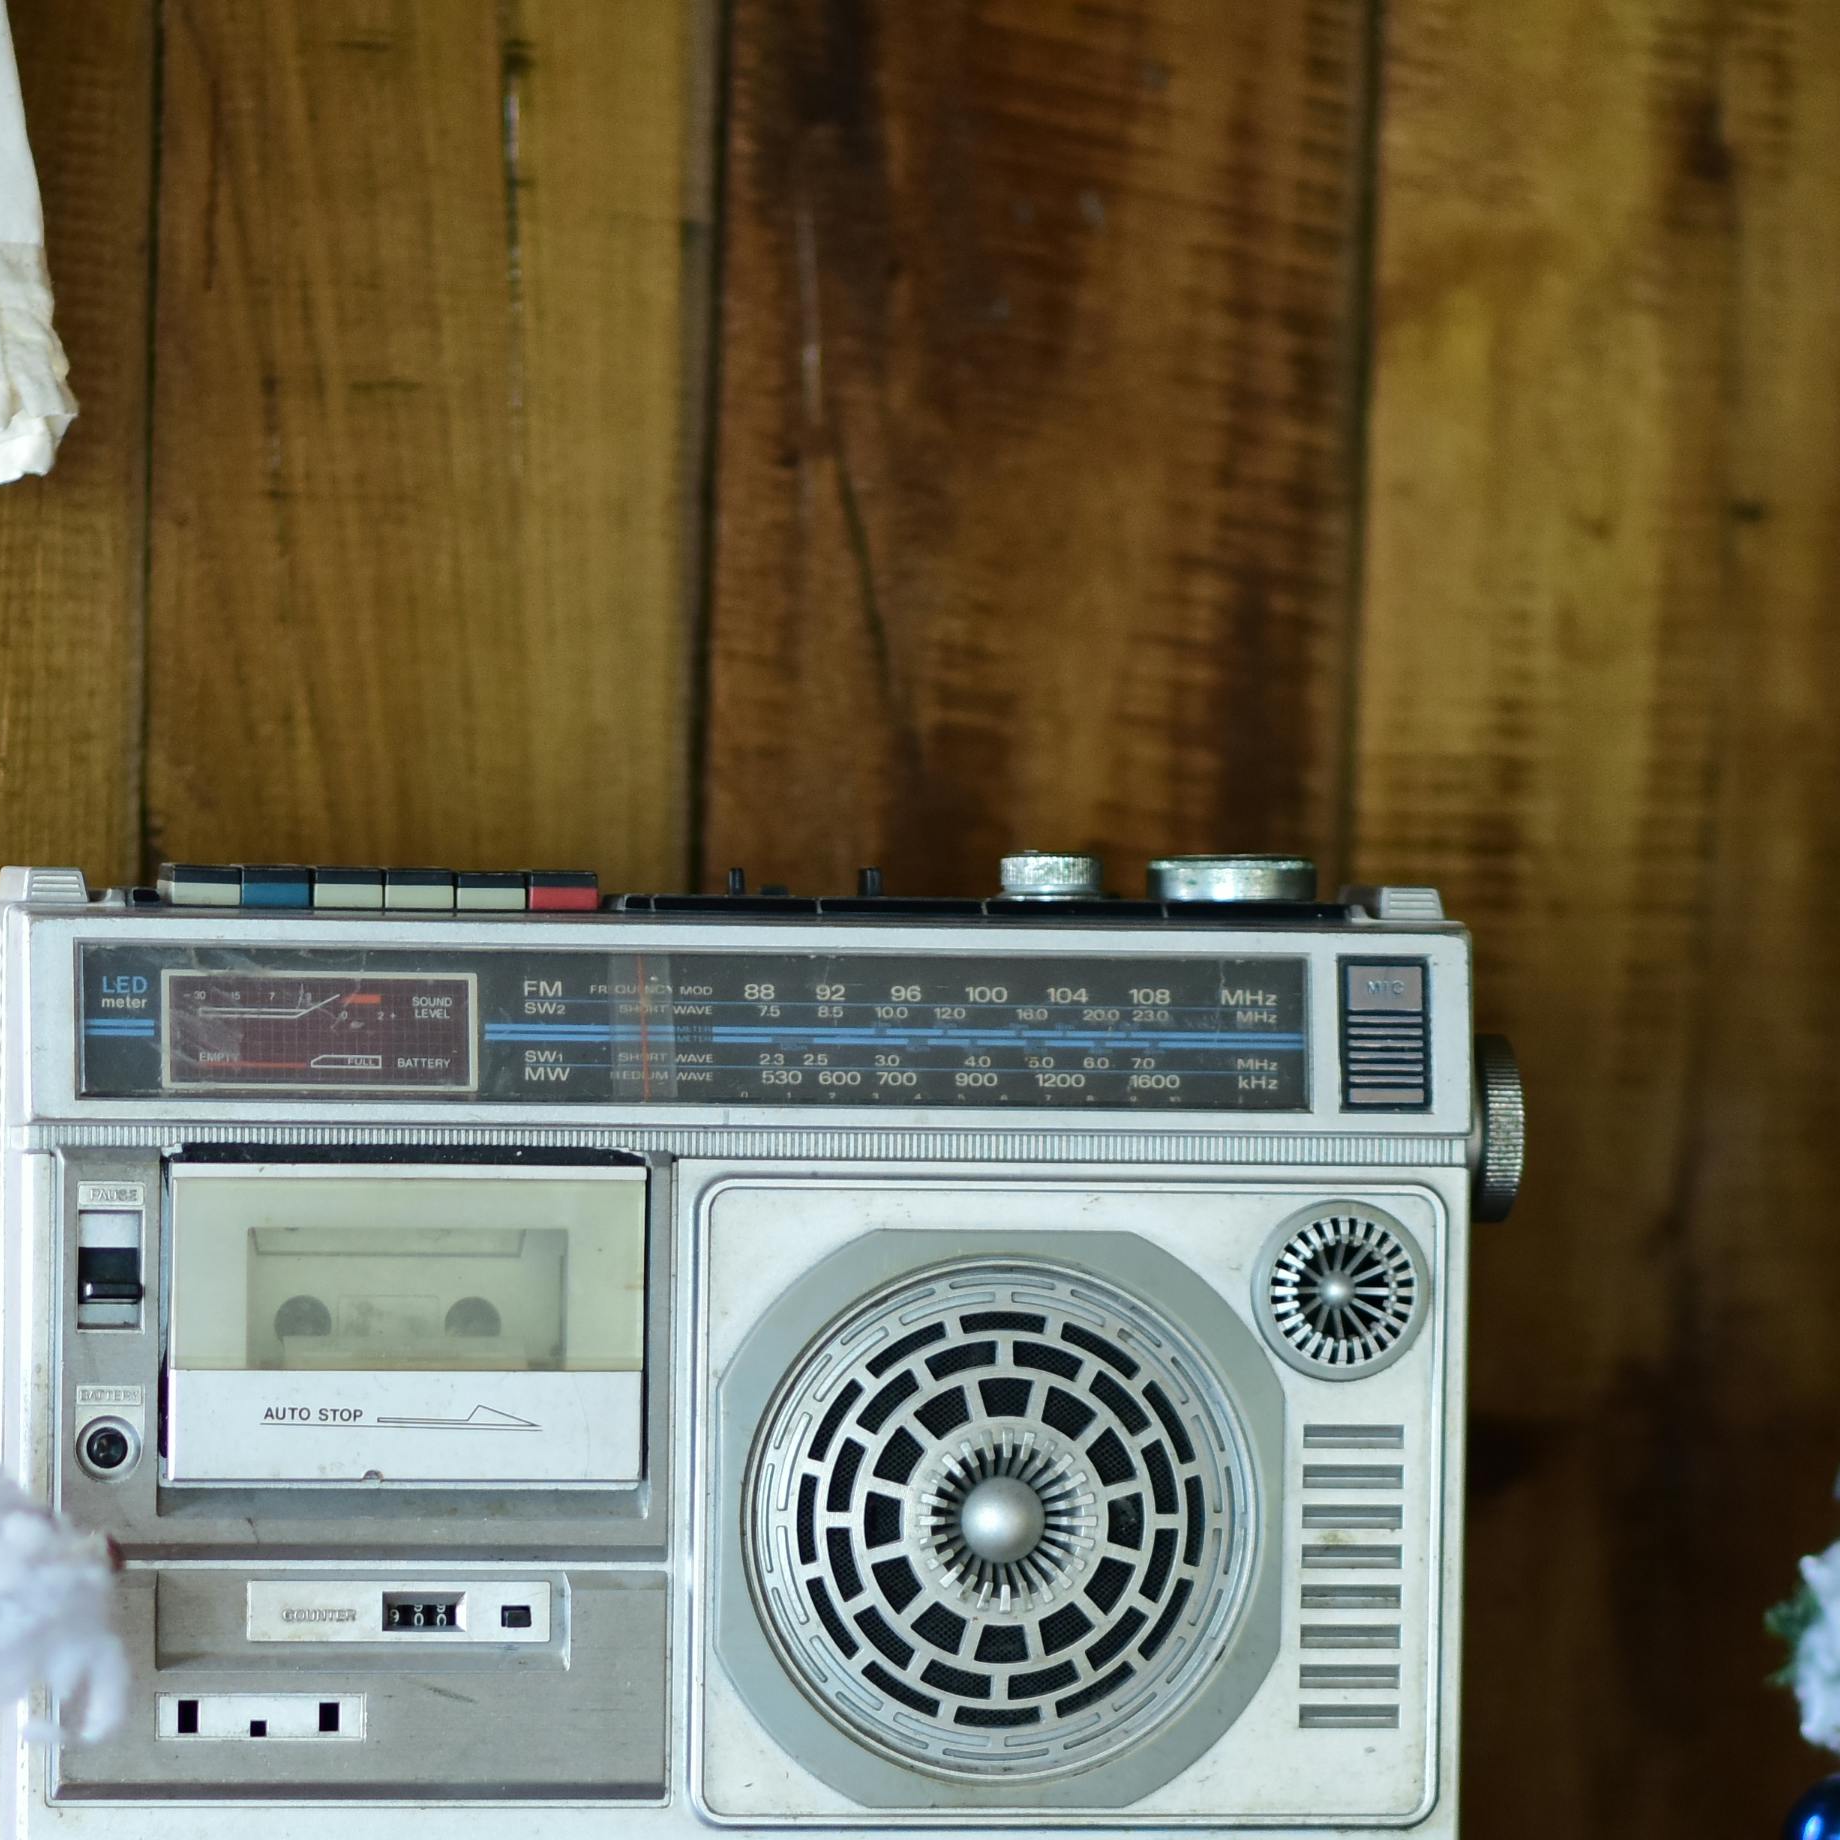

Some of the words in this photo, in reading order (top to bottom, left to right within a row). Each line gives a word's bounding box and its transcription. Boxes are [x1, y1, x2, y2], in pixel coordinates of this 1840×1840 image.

[101, 976, 148, 994] LED
[523, 980, 563, 997] FM
[679, 985, 713, 996] MOD
[743, 984, 775, 1001] 88
[815, 984, 846, 1001] 92
[890, 985, 922, 1002] 96
[965, 986, 1008, 1003] 100
[1046, 987, 1089, 1005] 104
[1128, 988, 1171, 1006] 108
[1221, 990, 1278, 1006] MHz
[101, 994, 148, 1010] meter
[412, 996, 453, 1007] SOUND
[414, 1009, 451, 1020] LEVEL
[523, 1002, 566, 1015] SW2
[672, 1004, 713, 1015] WAVE
[758, 1006, 781, 1017] 7.5
[817, 1006, 844, 1018] 8.5
[875, 1006, 908, 1019] 10.0
[934, 1007, 966, 1019] 12.0
[1016, 1008, 1048, 1021] 16.0
[1082, 1009, 1120, 1022] 20.0
[1132, 1009, 1170, 1022] 23.0
[1236, 1011, 1278, 1024] MHz
[347, 1058, 376, 1068] FULL
[397, 1057, 451, 1069] BATTERY
[524, 1049, 564, 1062] SW1
[675, 1053, 714, 1064] WAVE
[759, 1054, 785, 1066] 2.3
[803, 1054, 828, 1066] 2.5
[874, 1054, 900, 1067] 3.0
[964, 1055, 991, 1068] 4.0
[1027, 1056, 1054, 1070] 5.0
[1082, 1056, 1110, 1070] 6.0
[1132, 1057, 1156, 1070] 7.0
[1237, 1058, 1279, 1071] MHz
[524, 1066, 571, 1081] MW
[676, 1070, 714, 1082] WAVE
[761, 1070, 802, 1085] 530
[818, 1070, 861, 1085] 600
[876, 1071, 917, 1086] 700
[954, 1072, 998, 1087] 900
[1034, 1073, 1086, 1088] 1200
[1130, 1074, 1180, 1090] 1600
[1237, 1075, 1279, 1090] kHz
[264, 1406, 311, 1422] AUTO
[318, 1407, 364, 1422] STOP
[282, 1608, 357, 1622] COUNTER
